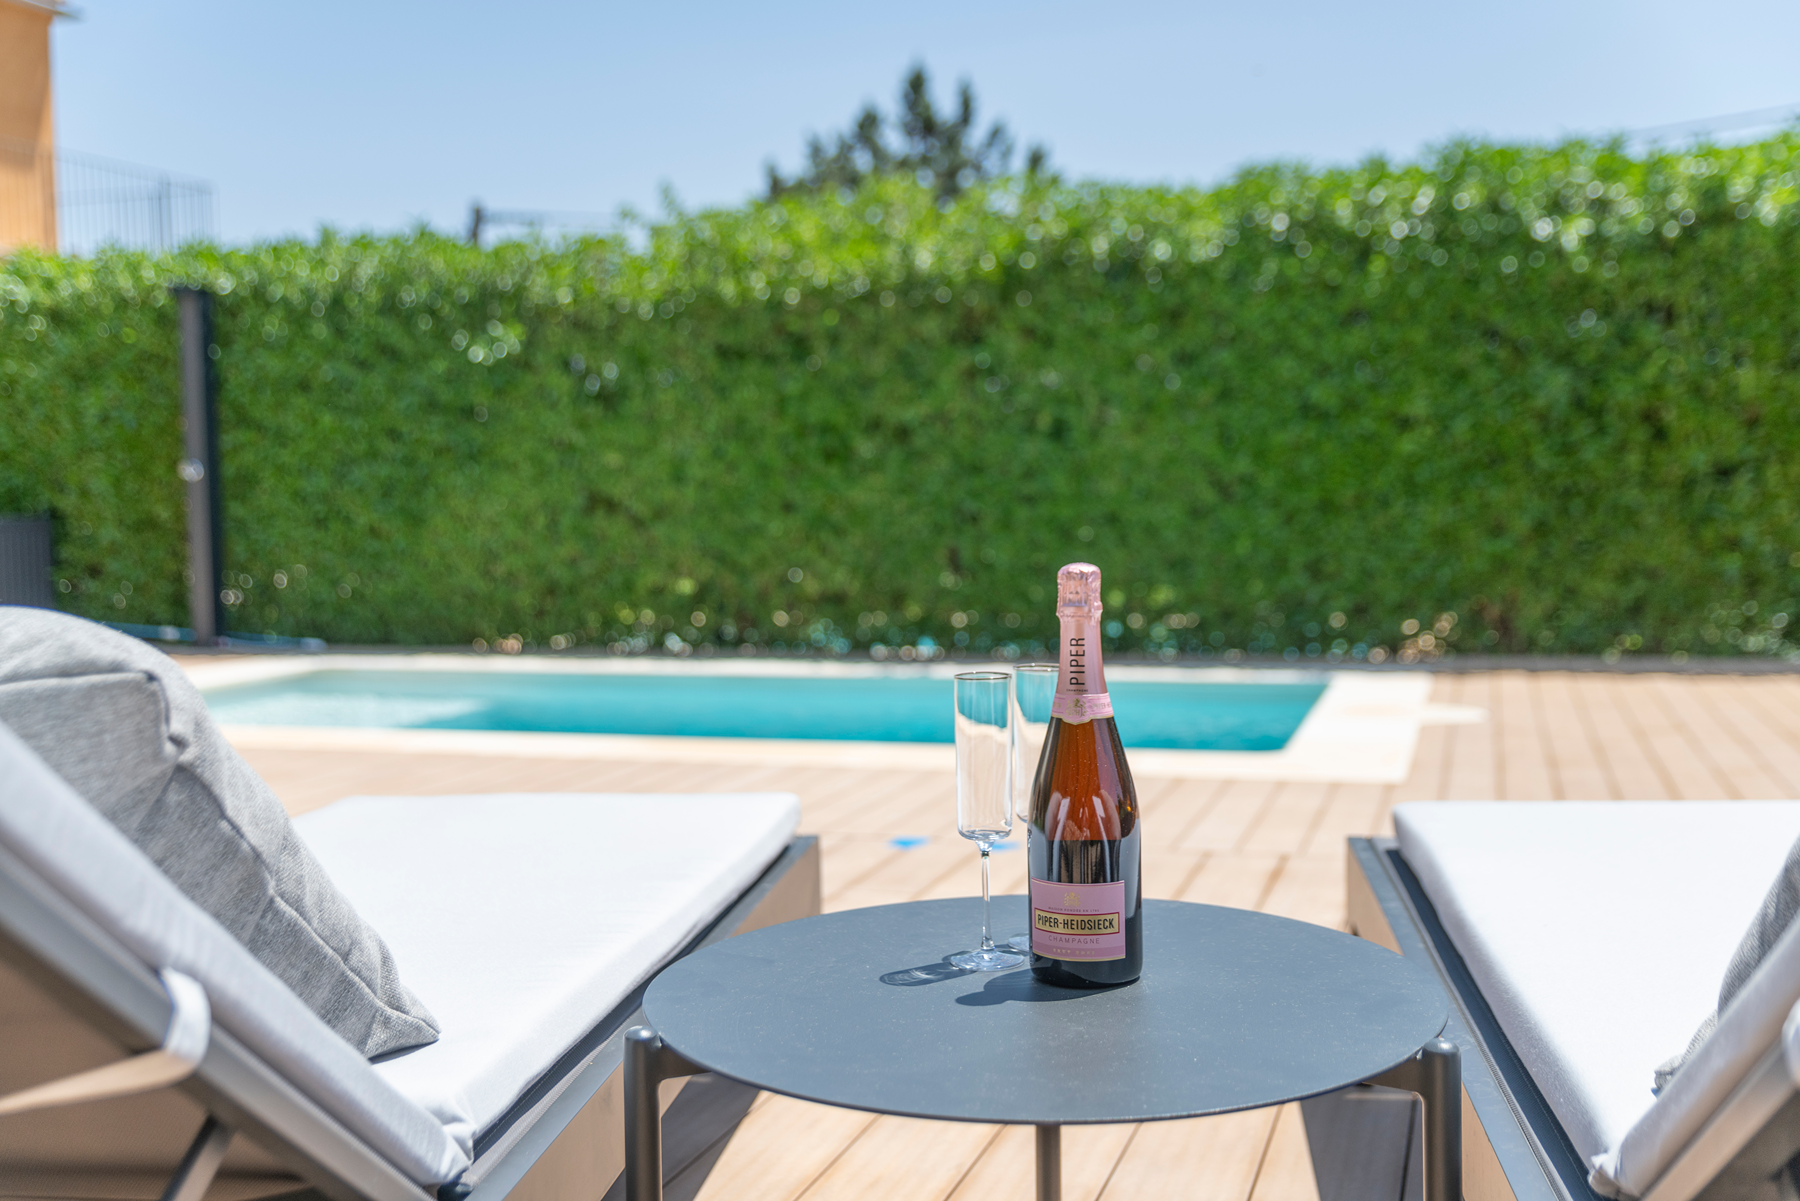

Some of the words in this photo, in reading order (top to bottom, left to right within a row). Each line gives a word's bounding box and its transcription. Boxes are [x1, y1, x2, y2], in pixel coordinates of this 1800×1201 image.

[1069, 637, 1086, 686] PIPER
[1037, 913, 1115, 931] PIPER-HEIDSIECK
[1048, 935, 1100, 945] CHAMPAGNE
